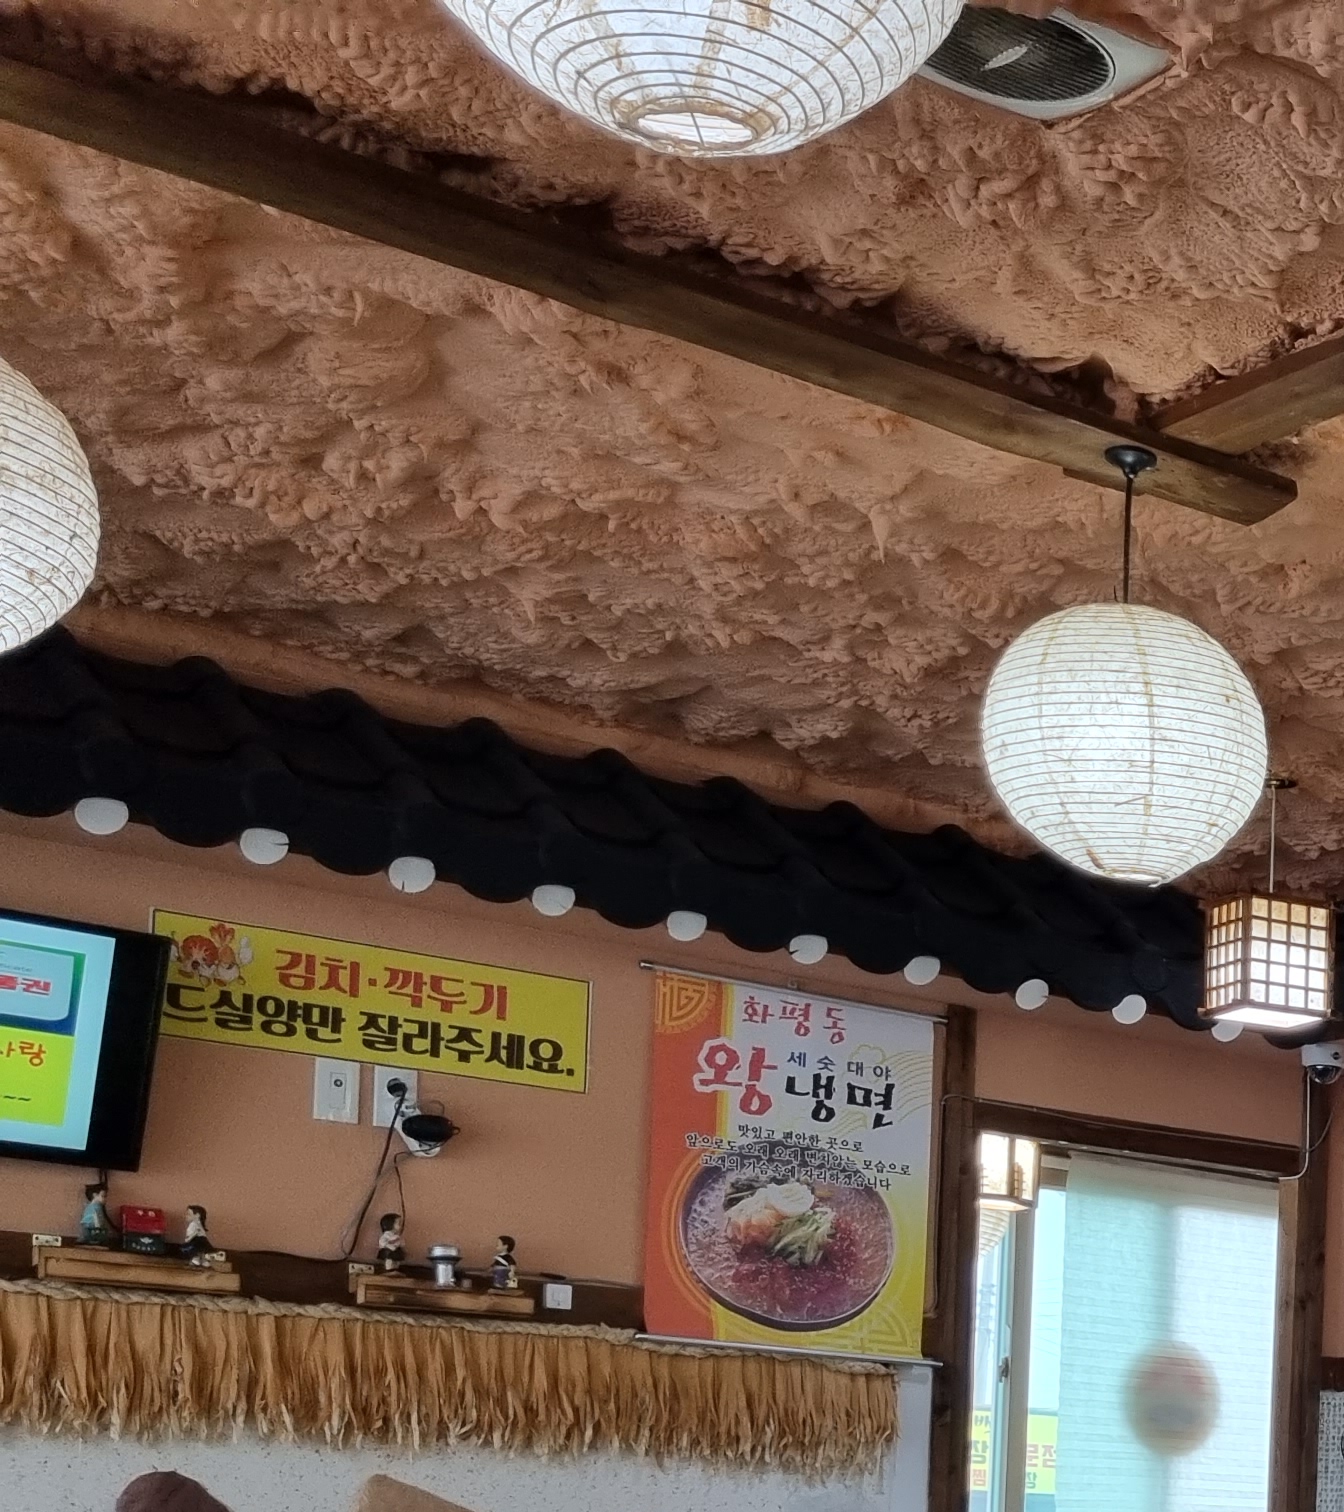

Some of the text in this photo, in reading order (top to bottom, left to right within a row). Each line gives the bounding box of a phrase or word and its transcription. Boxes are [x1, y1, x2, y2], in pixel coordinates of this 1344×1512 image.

[162, 983, 576, 1077] 드실양만 잘라주세요.
[742, 996, 847, 1044] 화평동
[686, 1133, 738, 1152] 앞으로도
[862, 1158, 912, 1176] 모습으로
[738, 1124, 863, 1153] 맛있고 편안한 곳으로
[701, 1154, 740, 1171] 고객의
